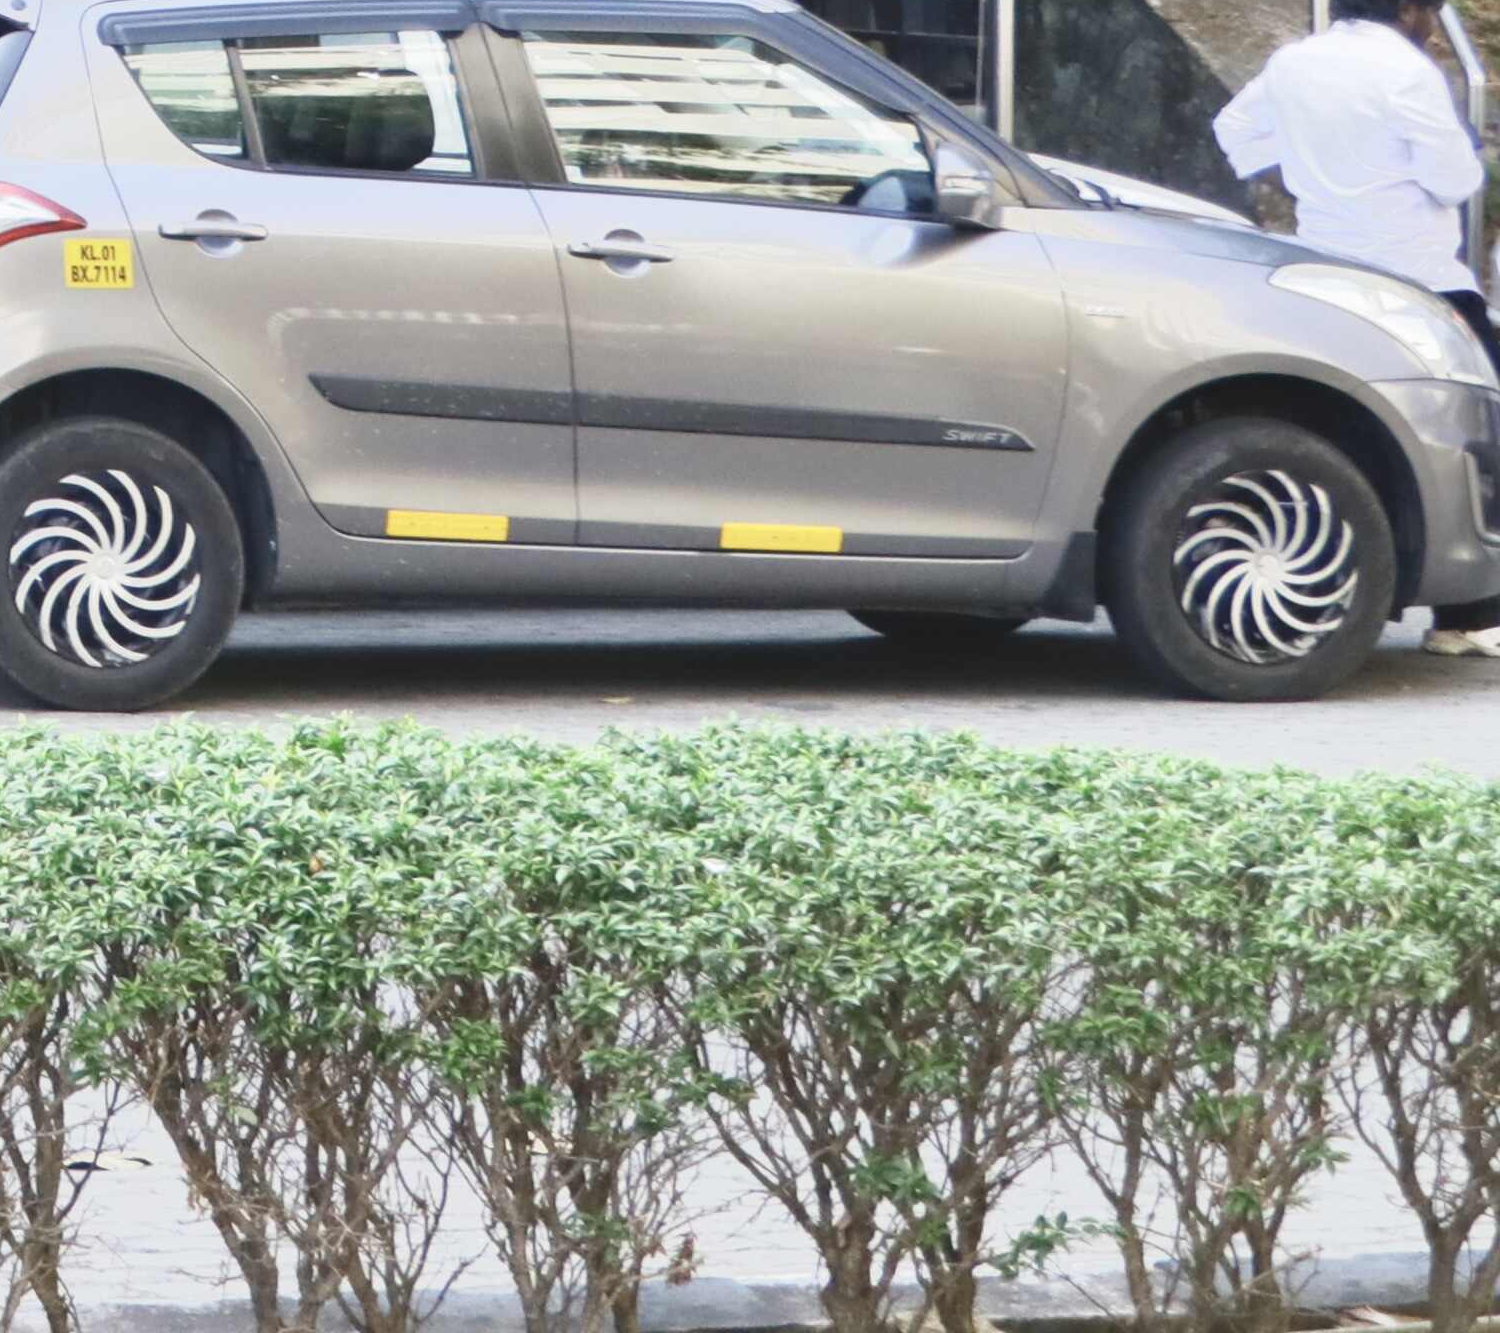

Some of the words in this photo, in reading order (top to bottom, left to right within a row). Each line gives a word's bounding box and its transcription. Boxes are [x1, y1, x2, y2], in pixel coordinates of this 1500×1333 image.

[80, 244, 116, 261] KL.01
[71, 265, 127, 283] BX.7114
[942, 429, 1013, 444] SWIFT
